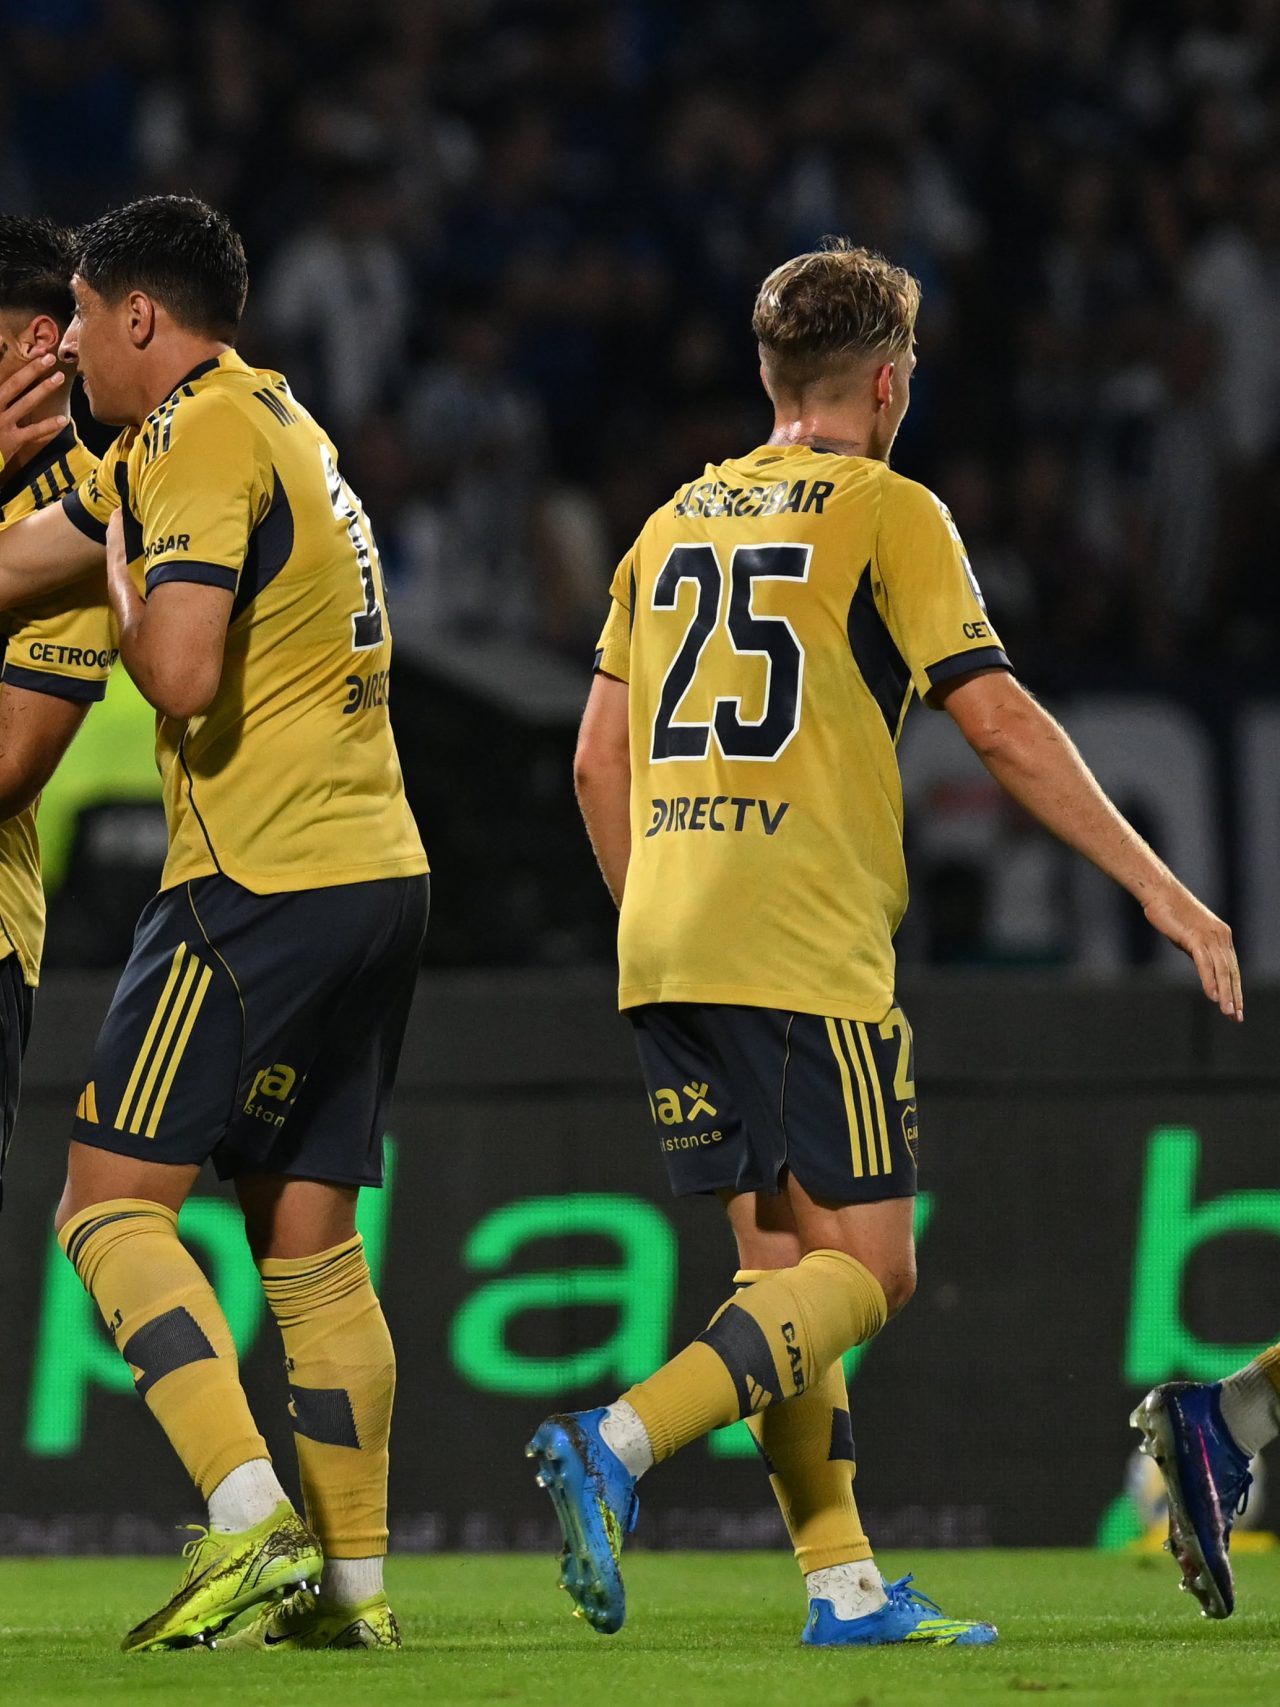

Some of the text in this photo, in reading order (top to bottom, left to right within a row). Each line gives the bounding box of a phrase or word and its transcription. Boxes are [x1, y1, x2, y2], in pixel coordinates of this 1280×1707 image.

[320, 442, 391, 652] 1
[649, 543, 814, 764] 25
[645, 795, 790, 837] DIRECTV
[878, 1007, 916, 1101] 2
